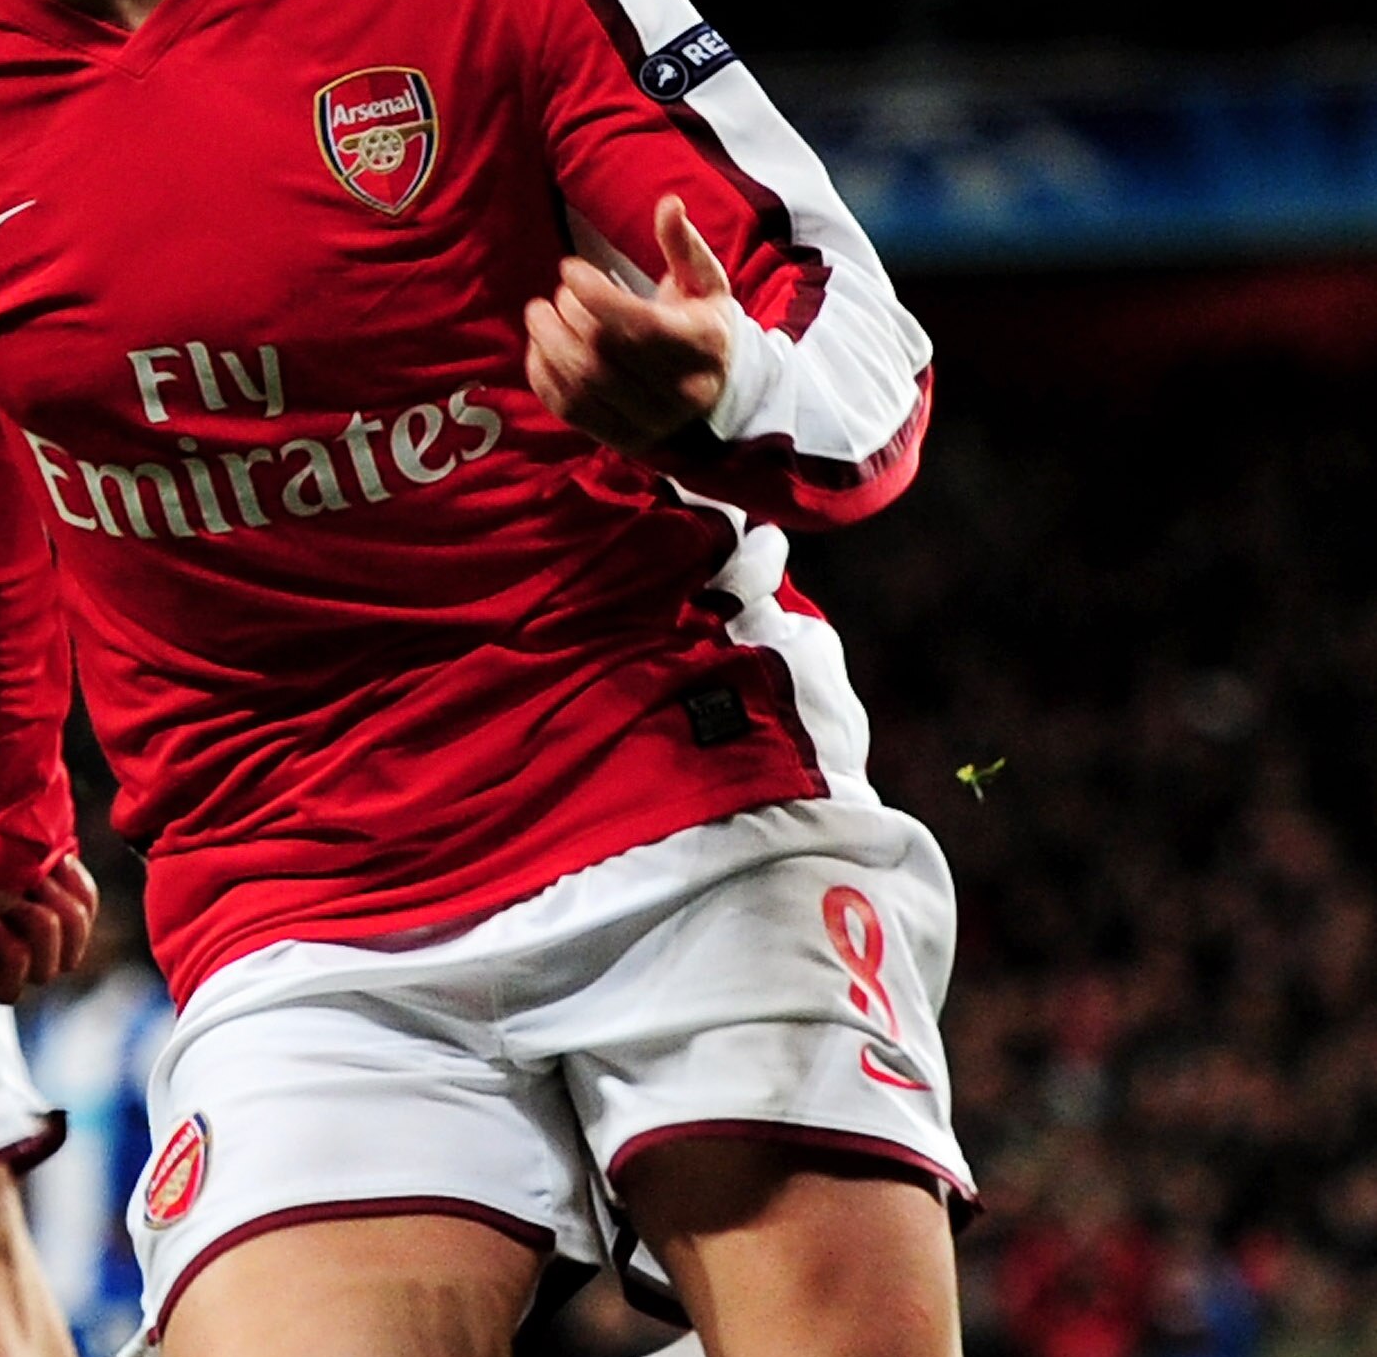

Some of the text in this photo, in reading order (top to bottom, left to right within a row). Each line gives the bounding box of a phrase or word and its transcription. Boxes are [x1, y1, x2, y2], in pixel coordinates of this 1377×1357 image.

[333, 88, 416, 128] Arsenal
[127, 340, 284, 424] Fly
[21, 381, 503, 540] Emirates
